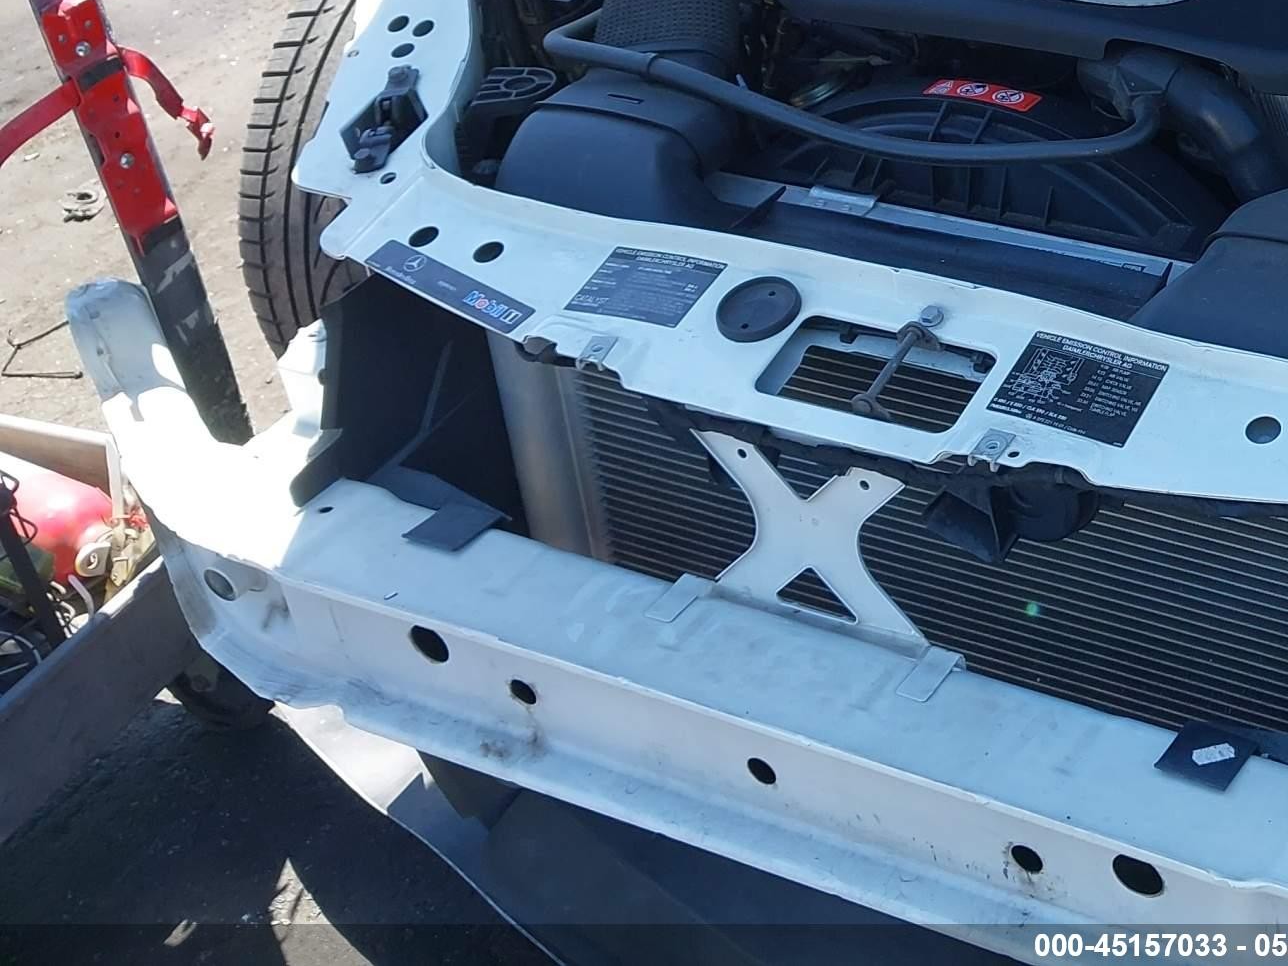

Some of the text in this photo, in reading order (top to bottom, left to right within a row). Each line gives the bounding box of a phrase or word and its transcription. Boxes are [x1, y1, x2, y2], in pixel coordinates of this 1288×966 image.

[463, 290, 506, 319] Mobil
[1035, 333, 1061, 343] VEHICLE
[1061, 339, 1093, 351] EMISSION
[1091, 347, 1122, 359] CONTROL
[1122, 356, 1168, 372] INFORMATION
[1061, 346, 1123, 366] DAIMLERCHRYSLER
